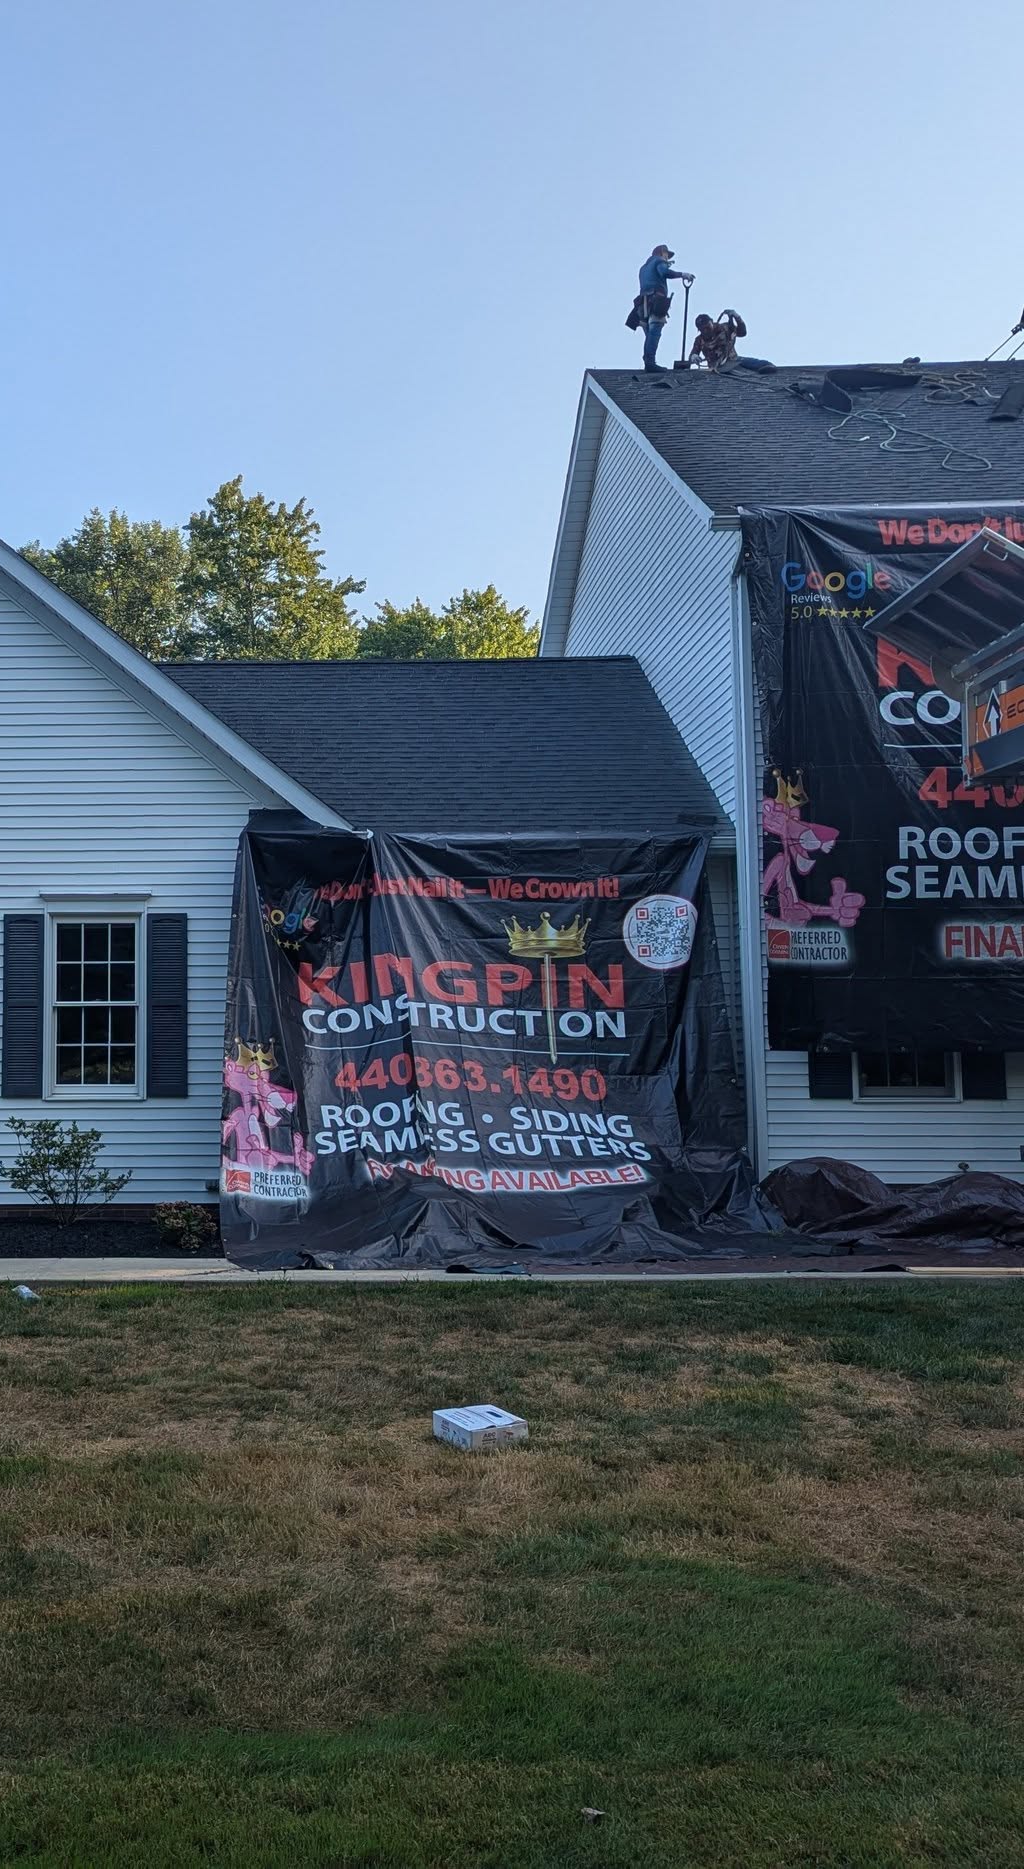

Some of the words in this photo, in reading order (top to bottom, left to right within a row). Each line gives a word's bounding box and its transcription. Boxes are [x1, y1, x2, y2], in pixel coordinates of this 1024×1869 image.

[878, 518, 925, 545] We
[781, 562, 892, 599] Google
[790, 592, 832, 604] Reviews
[790, 606, 813, 619] 5.0
[408, 876, 446, 898] Nail
[488, 879, 524, 900] We
[526, 877, 595, 900] Crown
[598, 877, 619, 898] It!
[885, 865, 1024, 899] SEAM
[945, 925, 1024, 957] FINA
[297, 953, 624, 1008] KINGPIN
[302, 993, 626, 1038] CONSTRUCTON
[510, 1106, 634, 1138] SIDING
[488, 1132, 652, 1161] GUTTERS
[254, 1172, 302, 1186] PREFERRED
[254, 1185, 308, 1197] CONTRACTOR
[491, 1164, 643, 1192] AVAILABLE!
